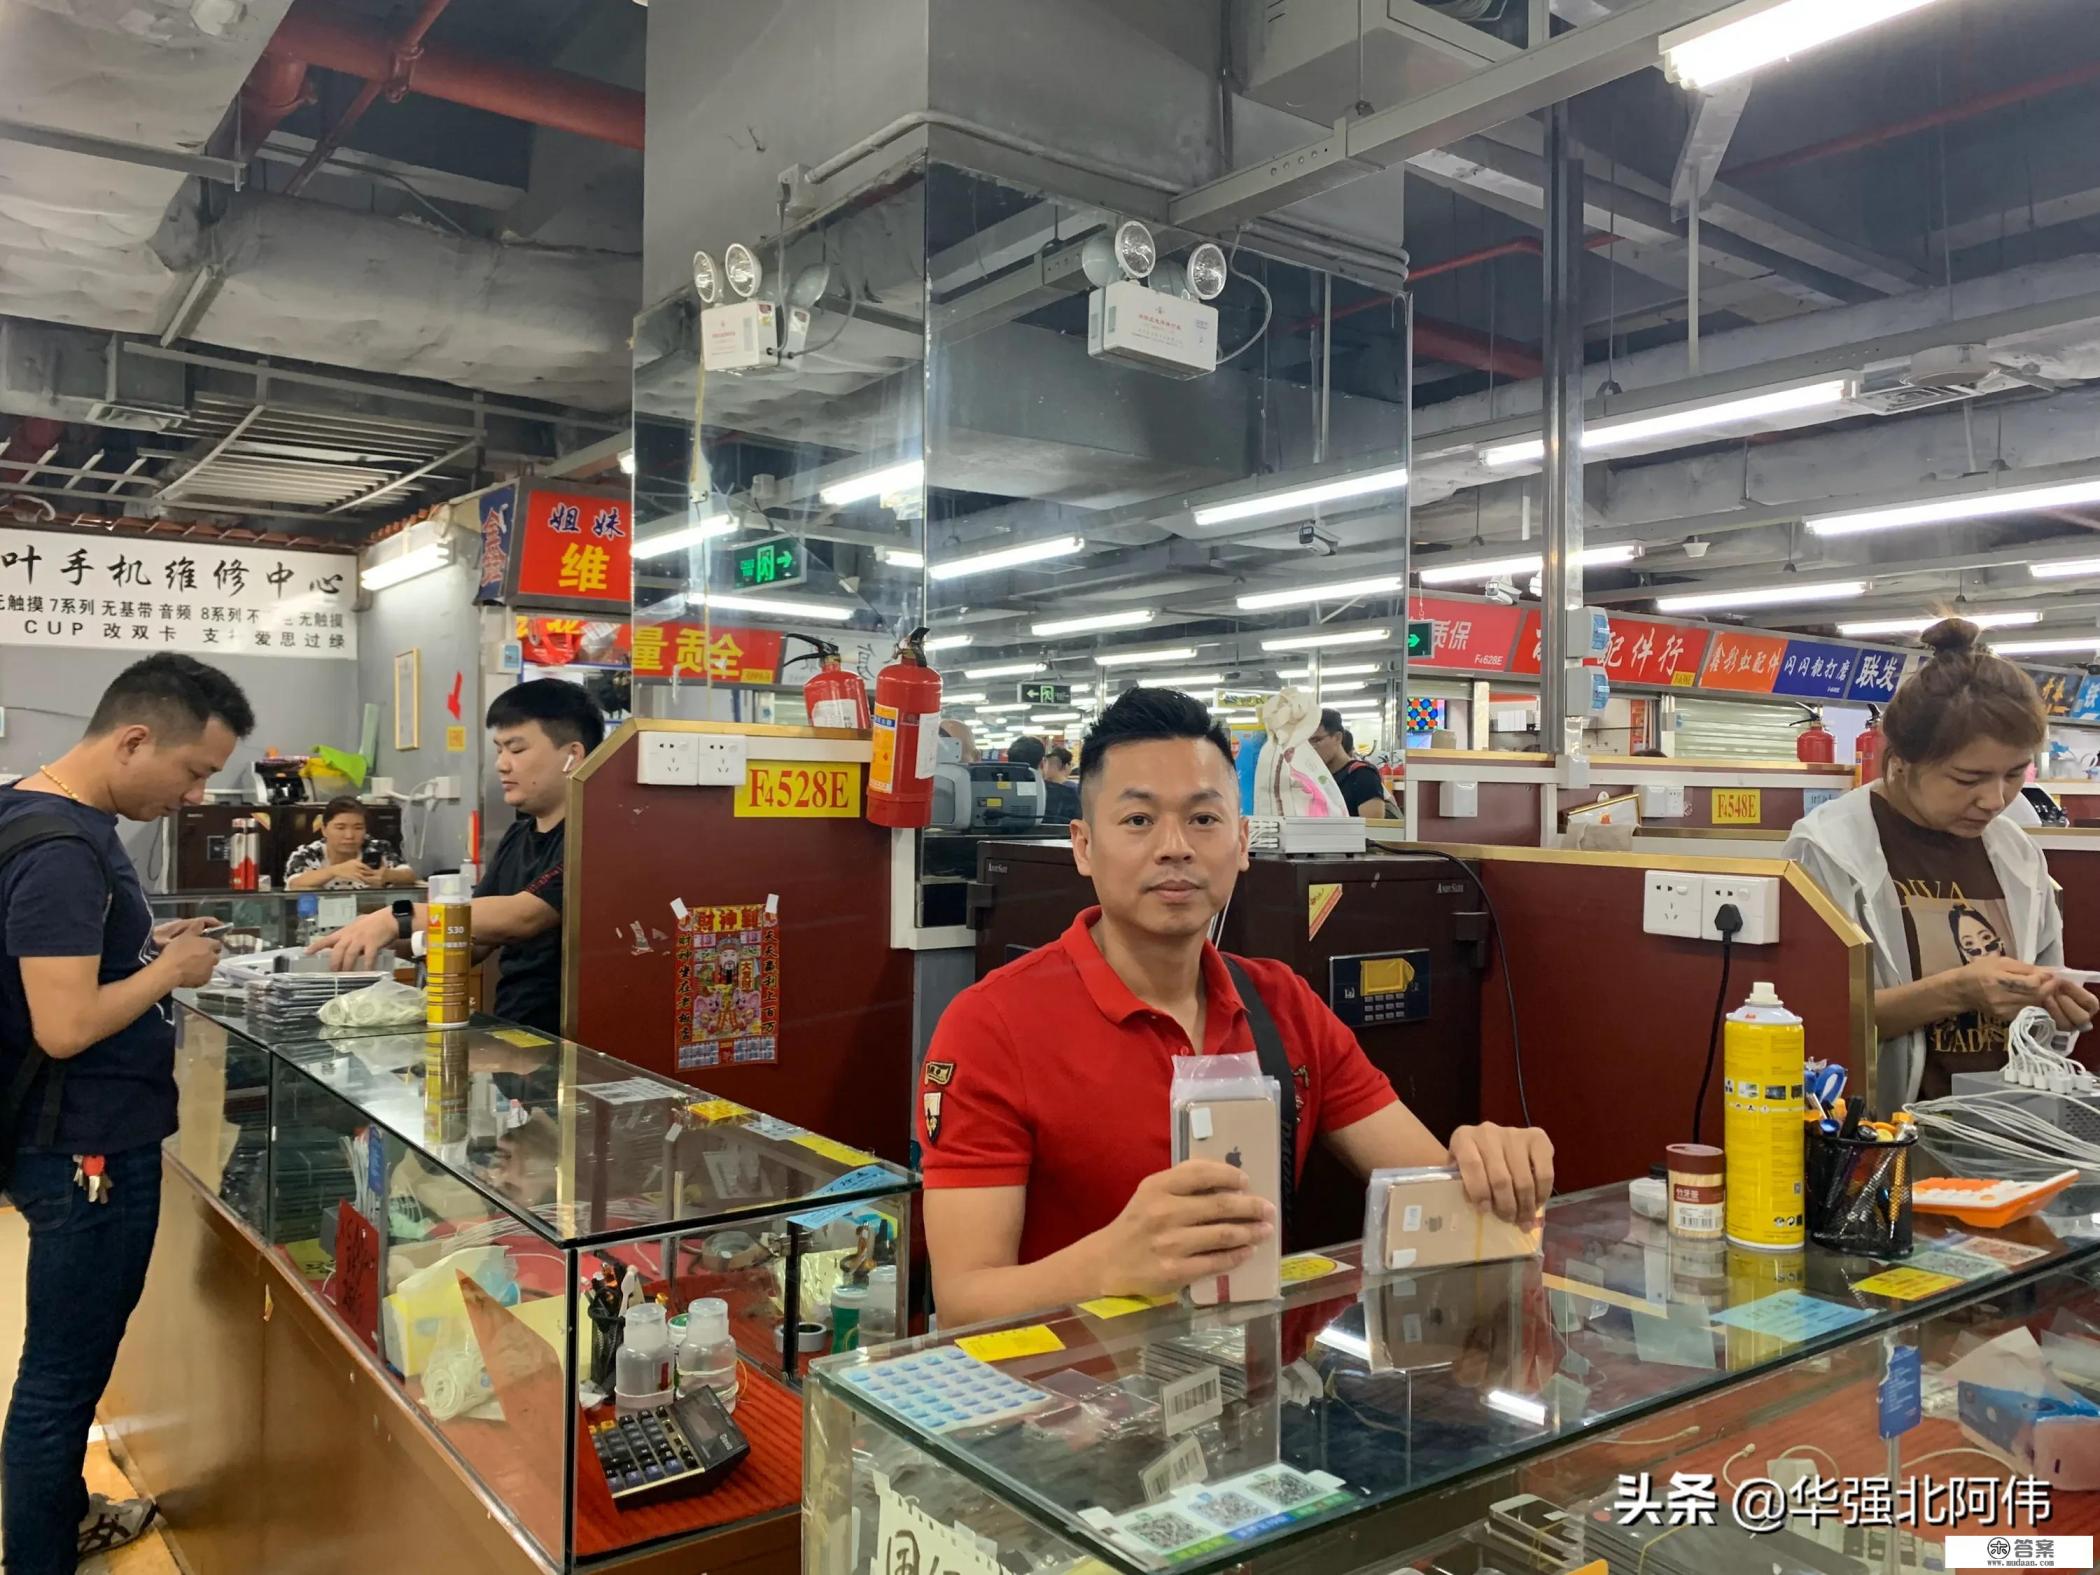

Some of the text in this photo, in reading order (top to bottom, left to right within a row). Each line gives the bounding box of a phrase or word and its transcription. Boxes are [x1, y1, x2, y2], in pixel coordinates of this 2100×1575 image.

[549, 502, 625, 538] 姐妹
[1, 545, 344, 599] 叶手机维修中心
[558, 541, 611, 592] 维
[50, 598, 95, 616] 7系列
[24, 619, 84, 635] CUP
[103, 622, 177, 642] 改双卡
